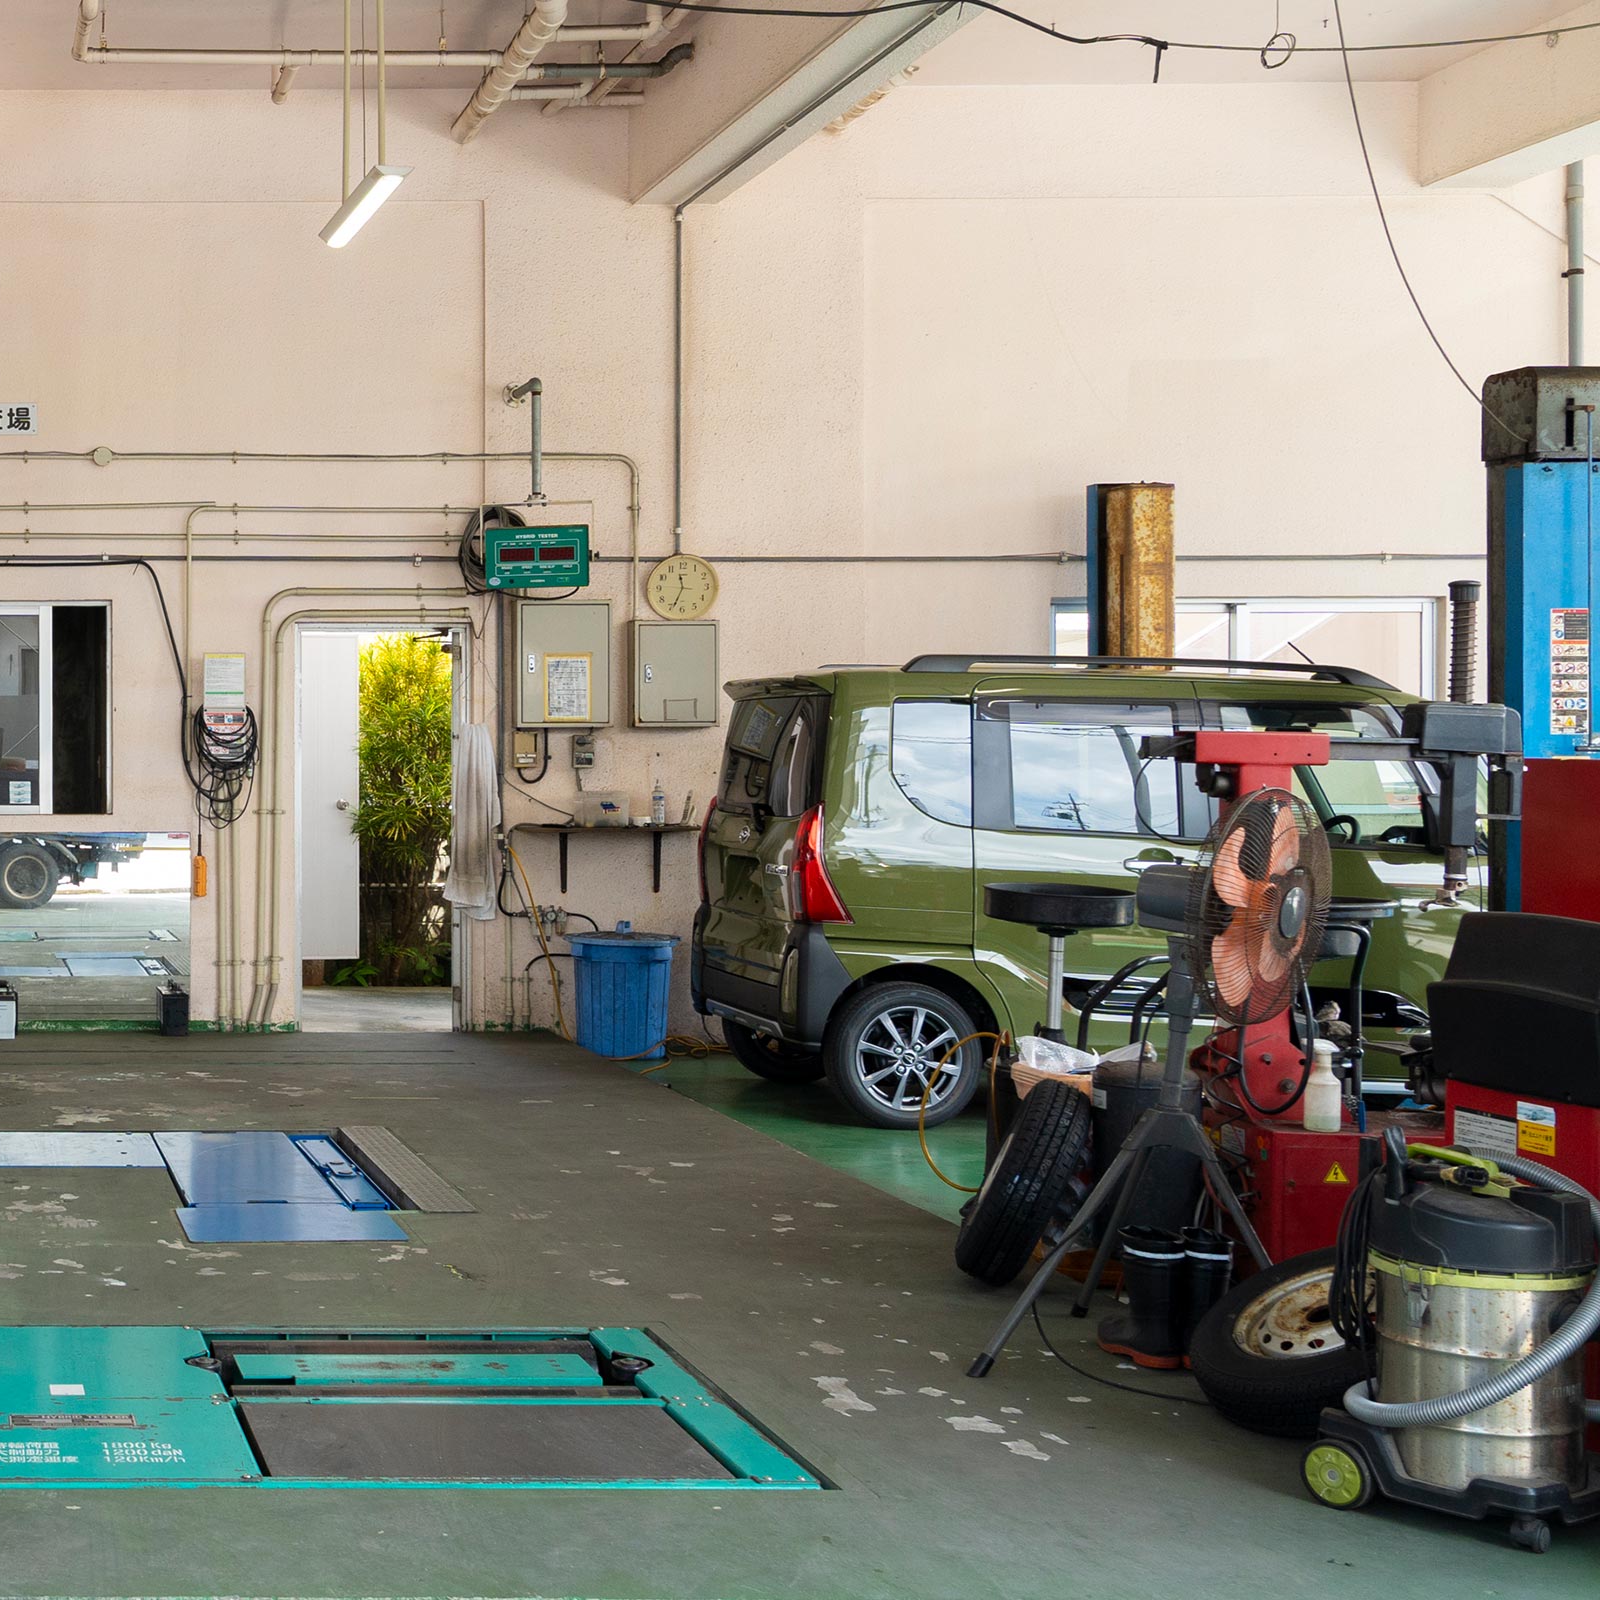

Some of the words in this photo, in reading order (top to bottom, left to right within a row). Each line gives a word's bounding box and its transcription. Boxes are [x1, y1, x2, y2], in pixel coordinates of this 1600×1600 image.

[668, 565, 674, 573] 11
[680, 562, 688, 570] 12
[693, 564, 697, 572] 1
[701, 572, 707, 580] 2
[656, 585, 662, 593] 9
[704, 583, 710, 591] 3
[659, 595, 665, 603] 8
[667, 603, 673, 611] 7
[691, 603, 698, 611] 5
[101, 1441, 147, 1449] 1800
[150, 1441, 172, 1449] Kg
[103, 1448, 148, 1456] 1200
[151, 1448, 183, 1456] daN
